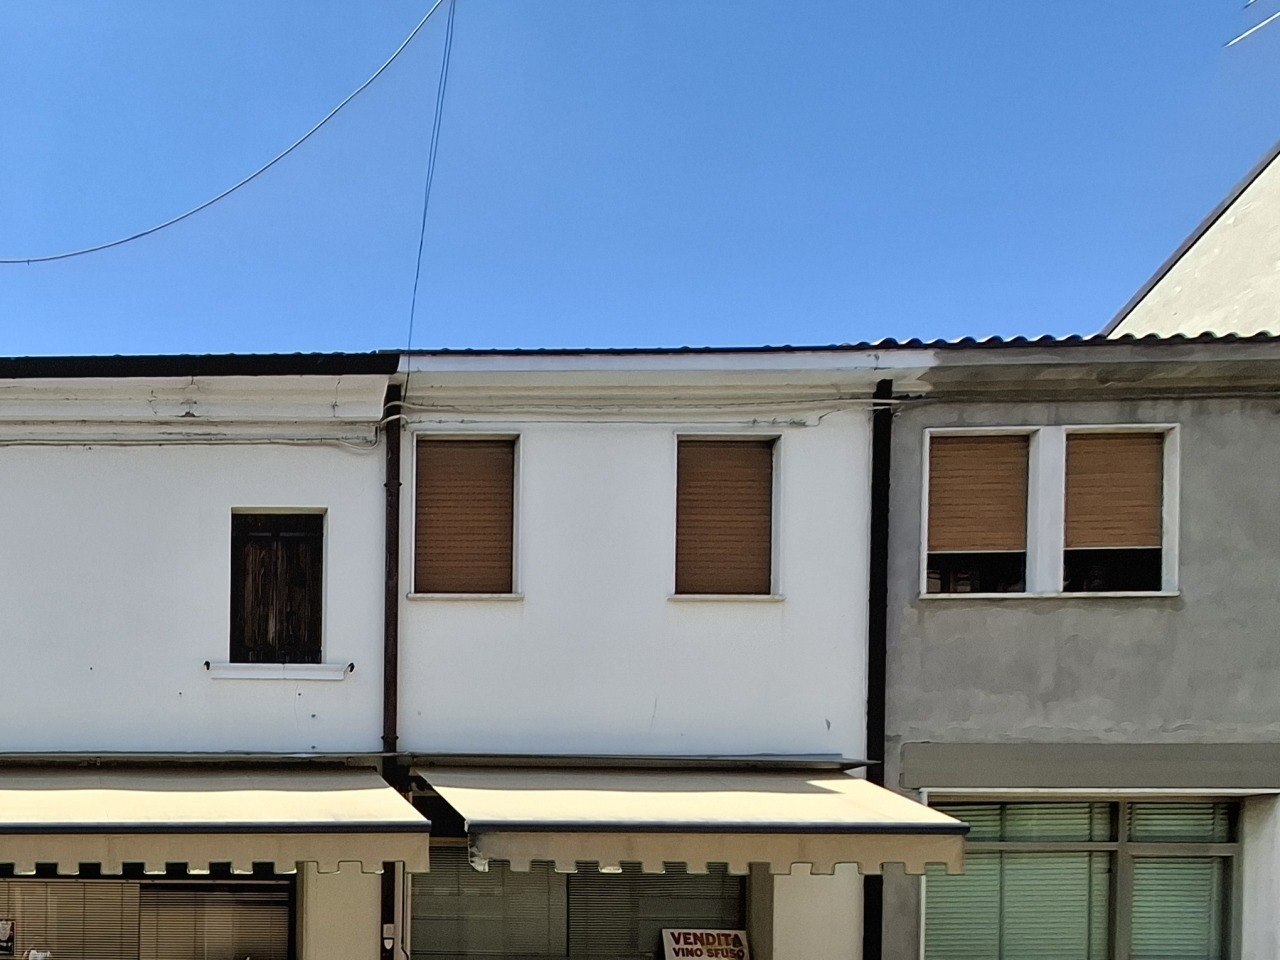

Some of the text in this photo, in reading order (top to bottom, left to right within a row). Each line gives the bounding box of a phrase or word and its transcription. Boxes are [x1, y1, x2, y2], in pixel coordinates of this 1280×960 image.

[670, 931, 743, 948] VENDITA
[672, 947, 745, 959] VINO SFUSO
